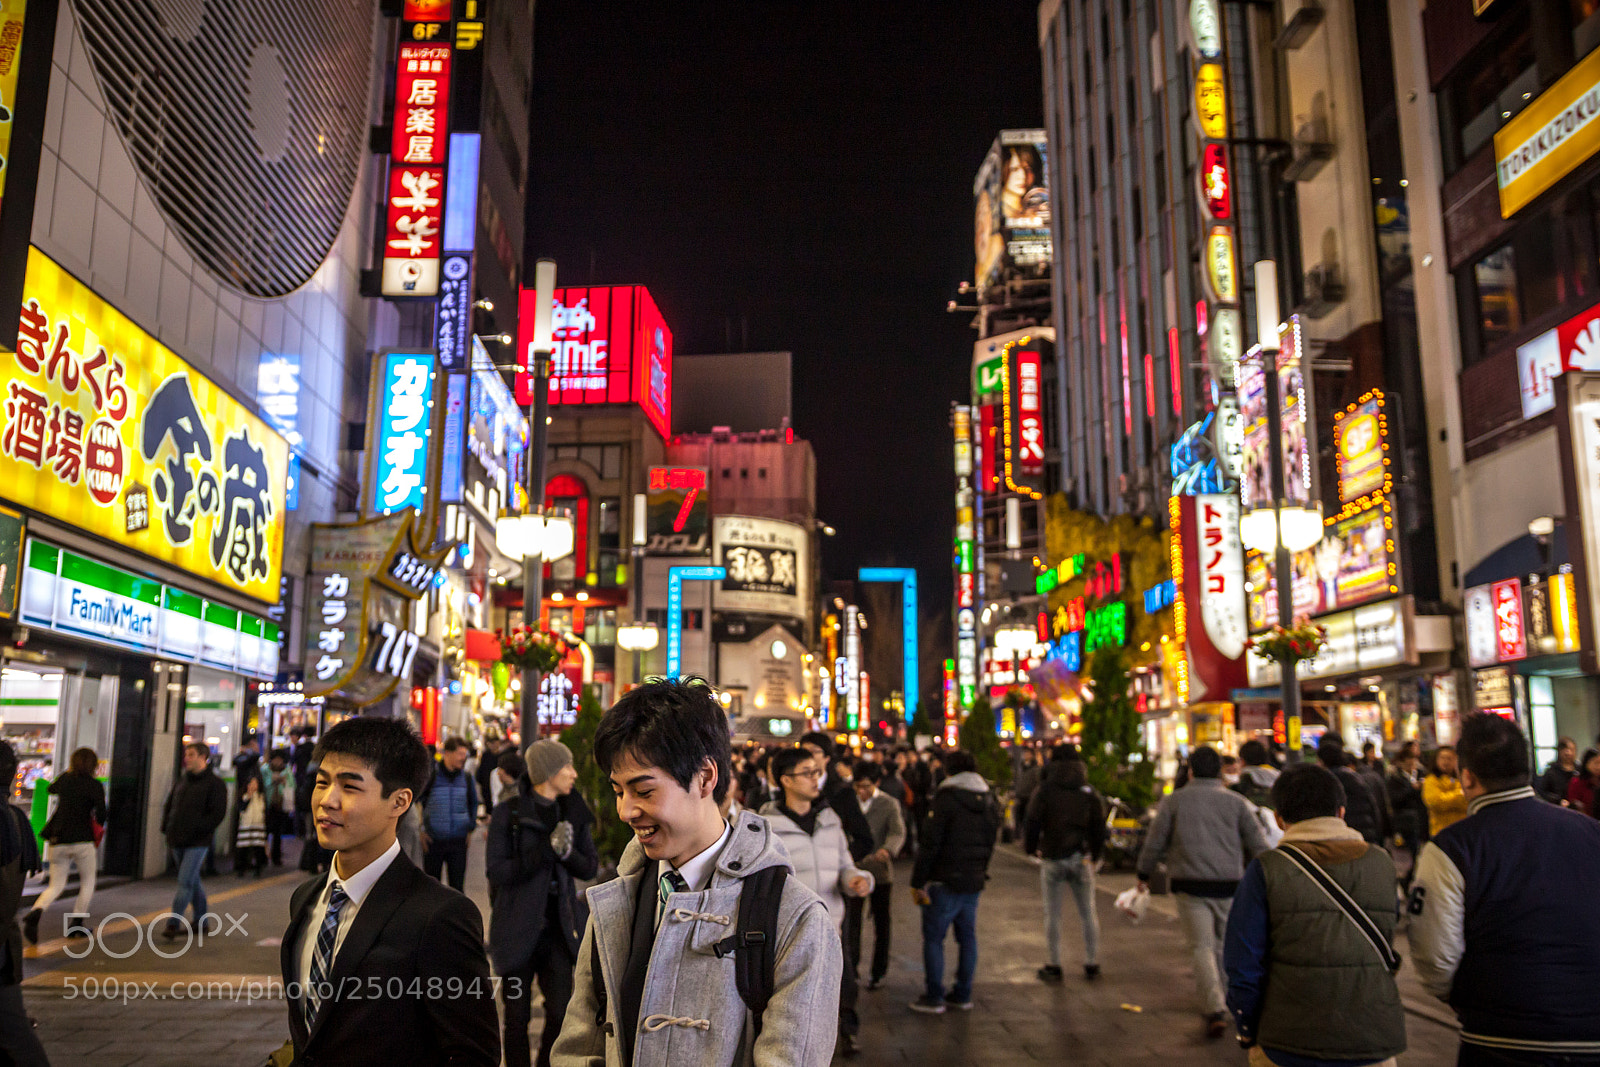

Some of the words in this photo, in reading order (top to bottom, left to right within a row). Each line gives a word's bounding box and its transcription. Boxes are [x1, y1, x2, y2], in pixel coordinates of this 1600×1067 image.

[412, 23, 441, 40] 6F
[404, 78, 438, 163] 居楽屋
[15, 301, 128, 421] きんくら
[3, 381, 86, 485] 酒場
[91, 424, 119, 447] KIN
[381, 359, 429, 507] カラオケ
[87, 468, 121, 492] KURA
[141, 371, 274, 587] 金の蔵
[1203, 503, 1226, 593] トラノコ
[70, 588, 154, 636] FamilyMart
[316, 574, 349, 680] カラオケ
[375, 621, 419, 680] 747
